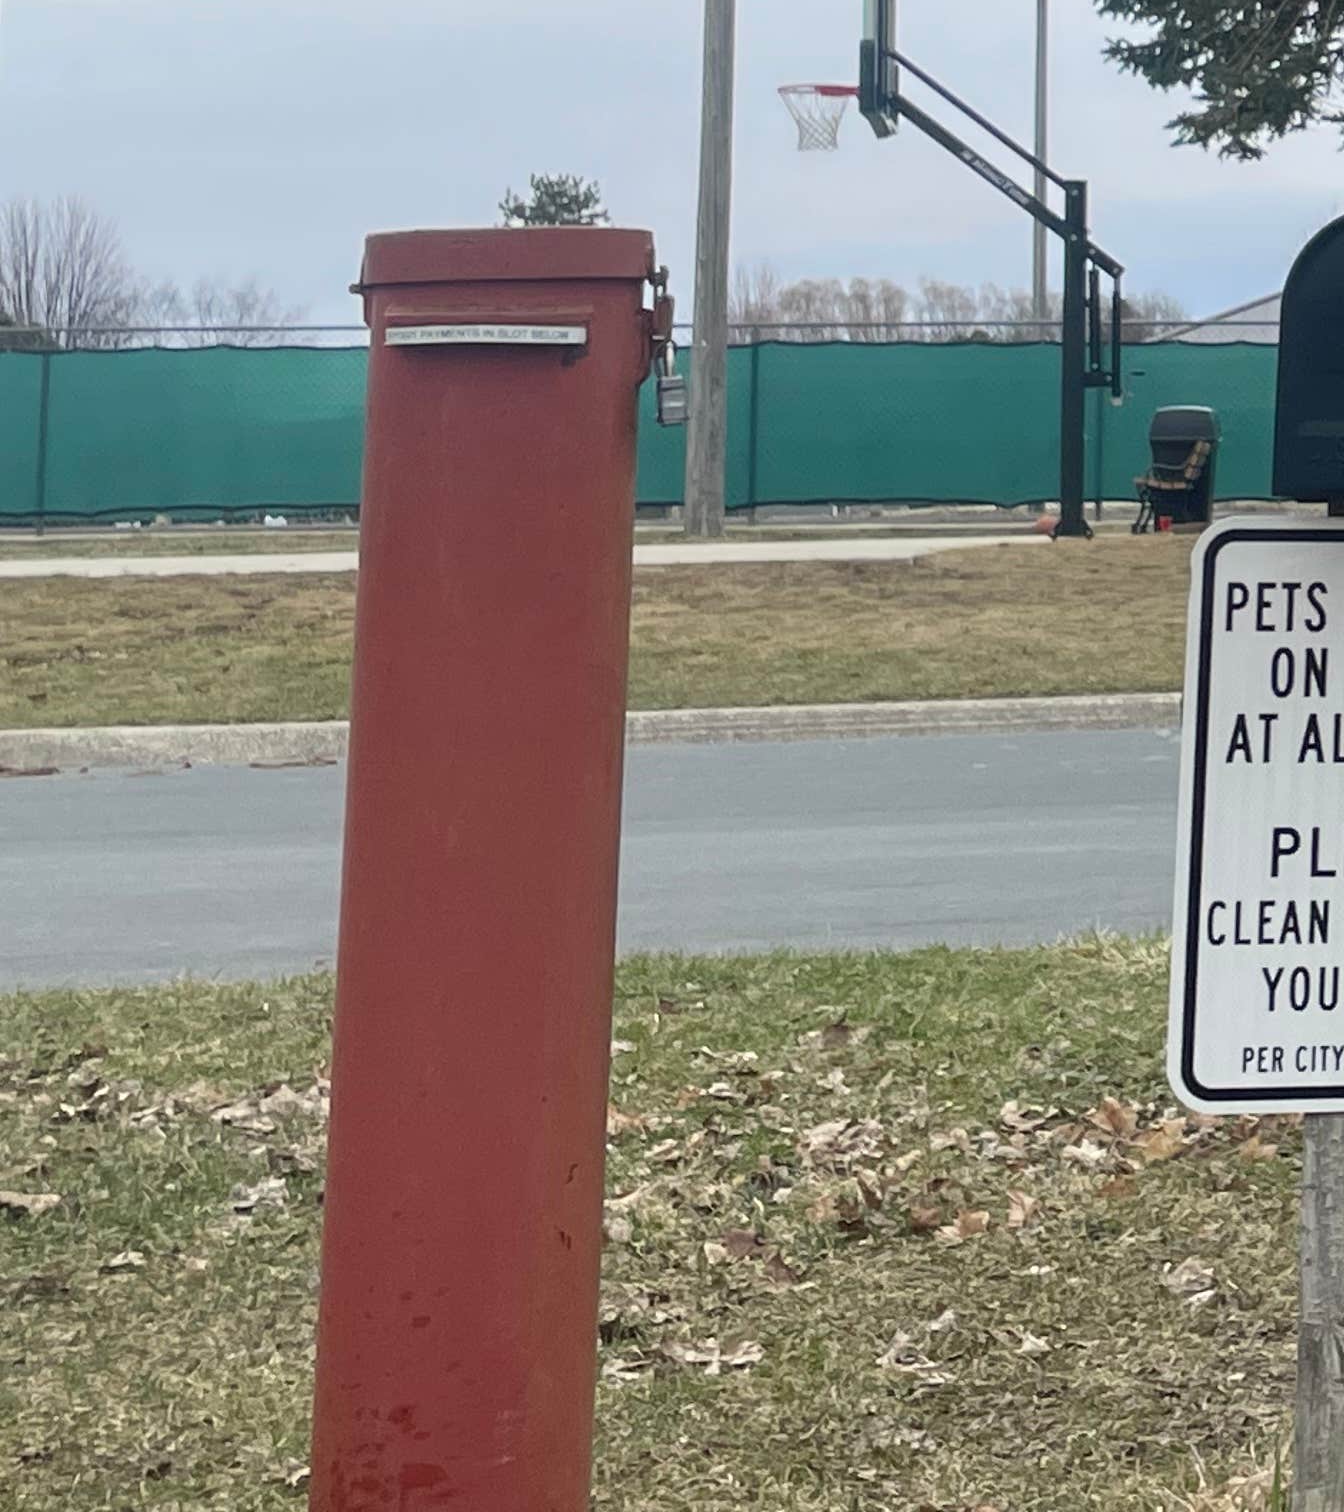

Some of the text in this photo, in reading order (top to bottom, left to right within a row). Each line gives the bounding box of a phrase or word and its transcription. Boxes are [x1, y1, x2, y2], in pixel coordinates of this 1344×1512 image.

[1225, 581, 1329, 633] PETS
[1271, 647, 1329, 698] ON
[1226, 713, 1279, 764] AT
[1207, 900, 1330, 945] CLEAN
[1242, 1046, 1284, 1073] PER
[1296, 1045, 1344, 1072] CITY
